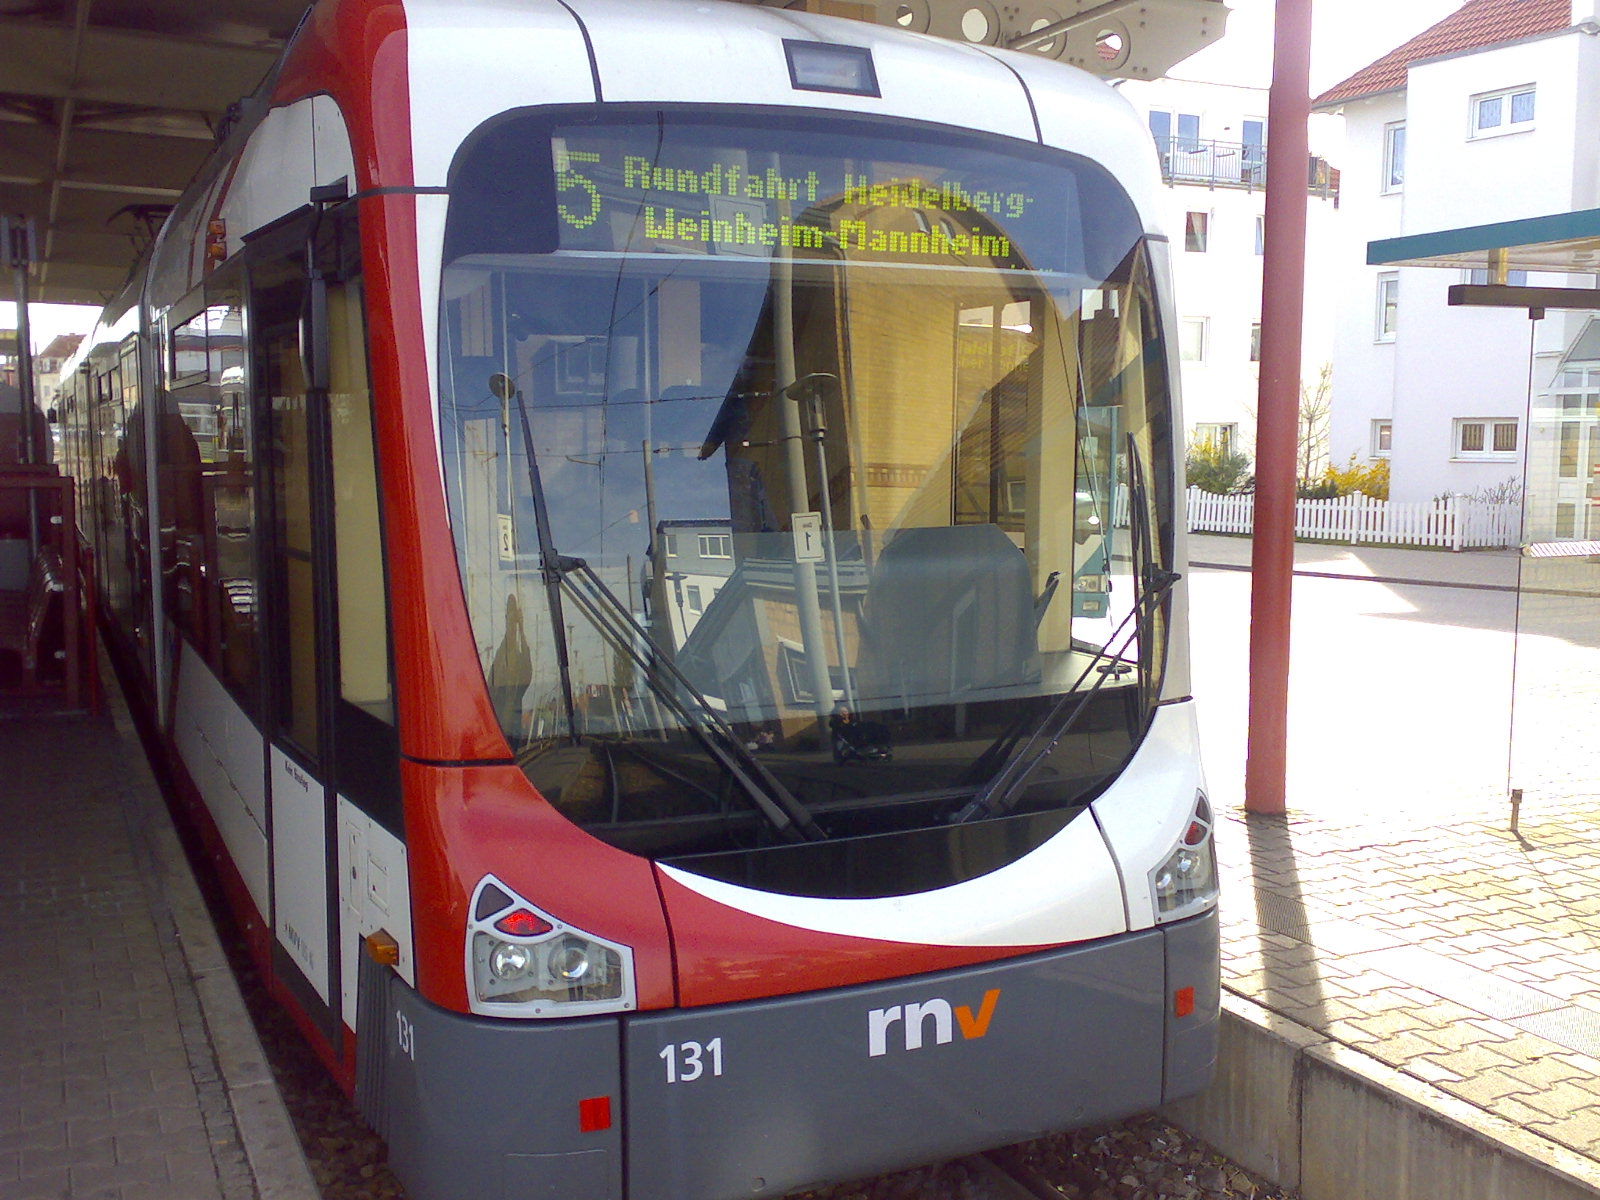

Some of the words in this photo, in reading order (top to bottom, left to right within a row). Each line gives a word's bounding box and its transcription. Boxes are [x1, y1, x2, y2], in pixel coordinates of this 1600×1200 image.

[557, 151, 600, 229] 5
[624, 155, 820, 202] Rundfahrt
[645, 206, 1010, 257] Weinheim-Mannheim
[396, 1009, 415, 1062] 131
[868, 988, 1002, 1058] rnv
[659, 1037, 722, 1084] 131
